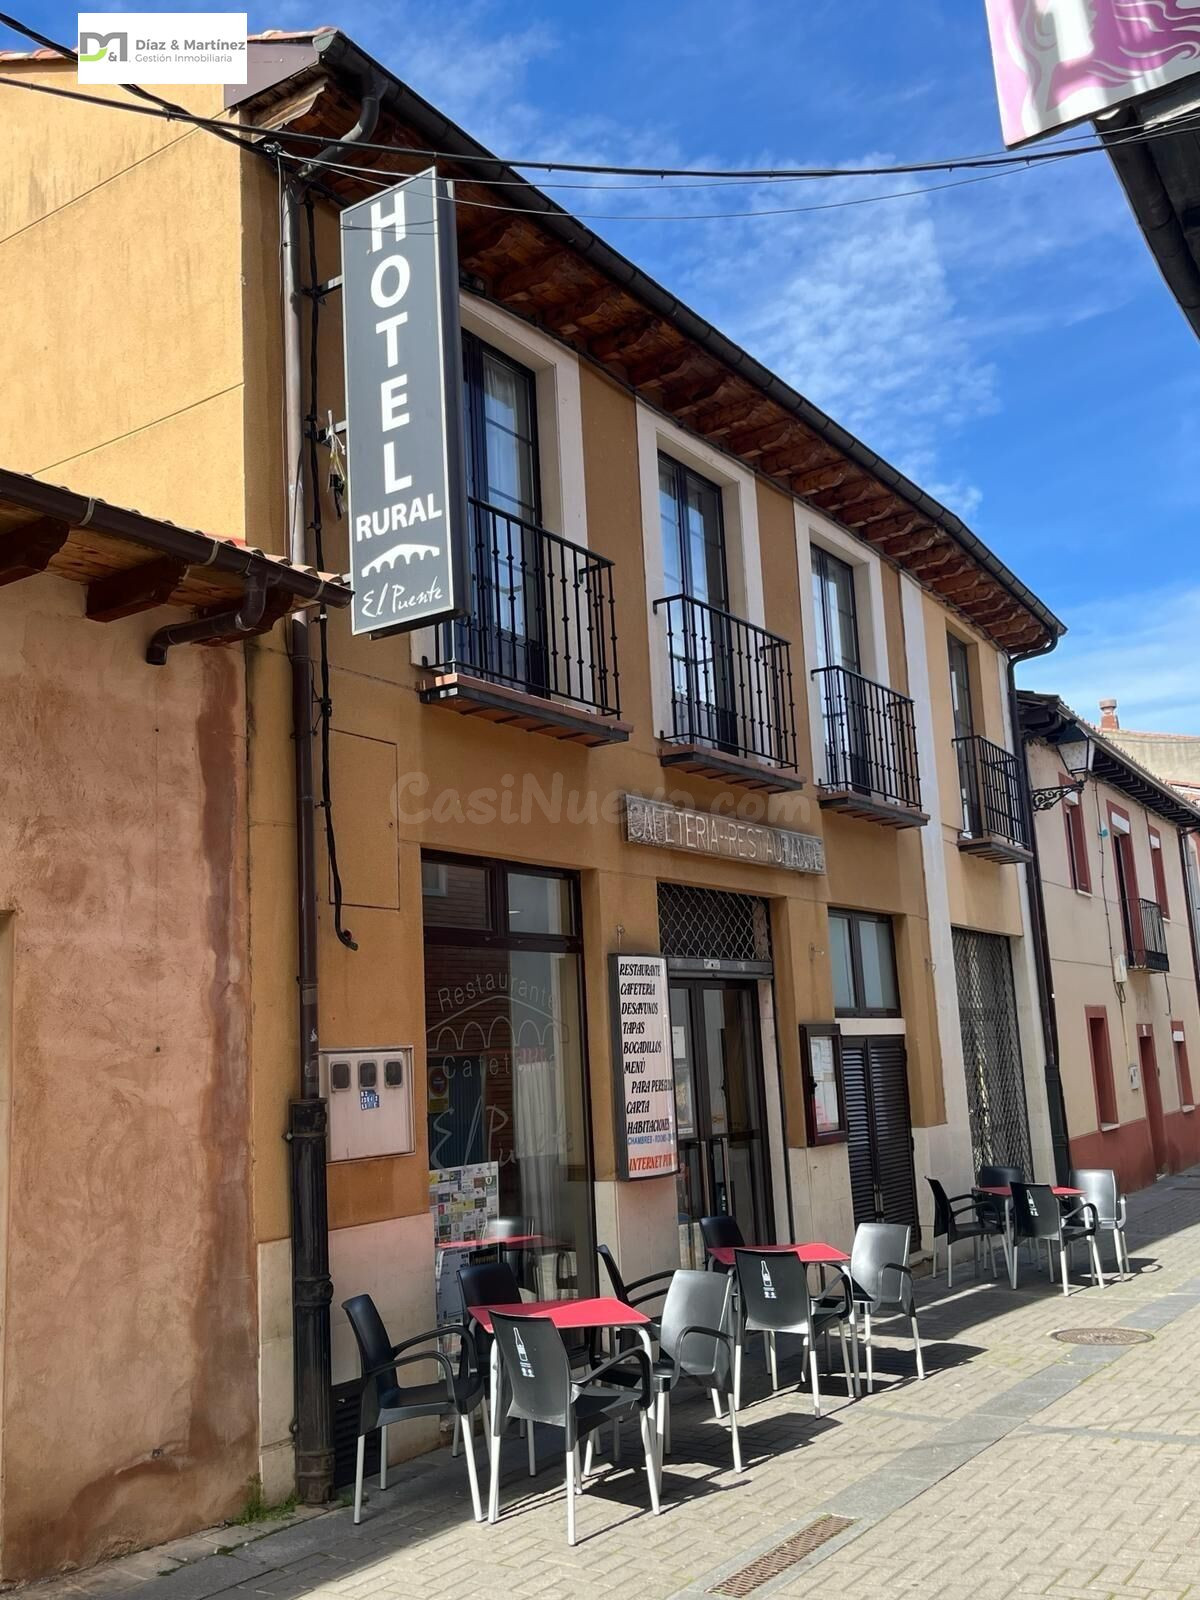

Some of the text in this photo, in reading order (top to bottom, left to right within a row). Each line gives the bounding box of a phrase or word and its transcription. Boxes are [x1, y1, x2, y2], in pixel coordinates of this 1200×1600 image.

[370, 190, 412, 495] HOTEL
[356, 493, 443, 542] RURAL
[361, 576, 444, 618] El Puente
[619, 963, 661, 977] RESTAURANTE
[621, 1002, 659, 1015] DESAYUNOS
[622, 1021, 646, 1034] TAPAS
[623, 1040, 662, 1055] BOCADILLOS
[623, 1057, 646, 1074] MENÚ
[631, 1080, 650, 1094] PARA
[626, 1100, 650, 1114] CARTA
[629, 1155, 662, 1171] INTERNET
